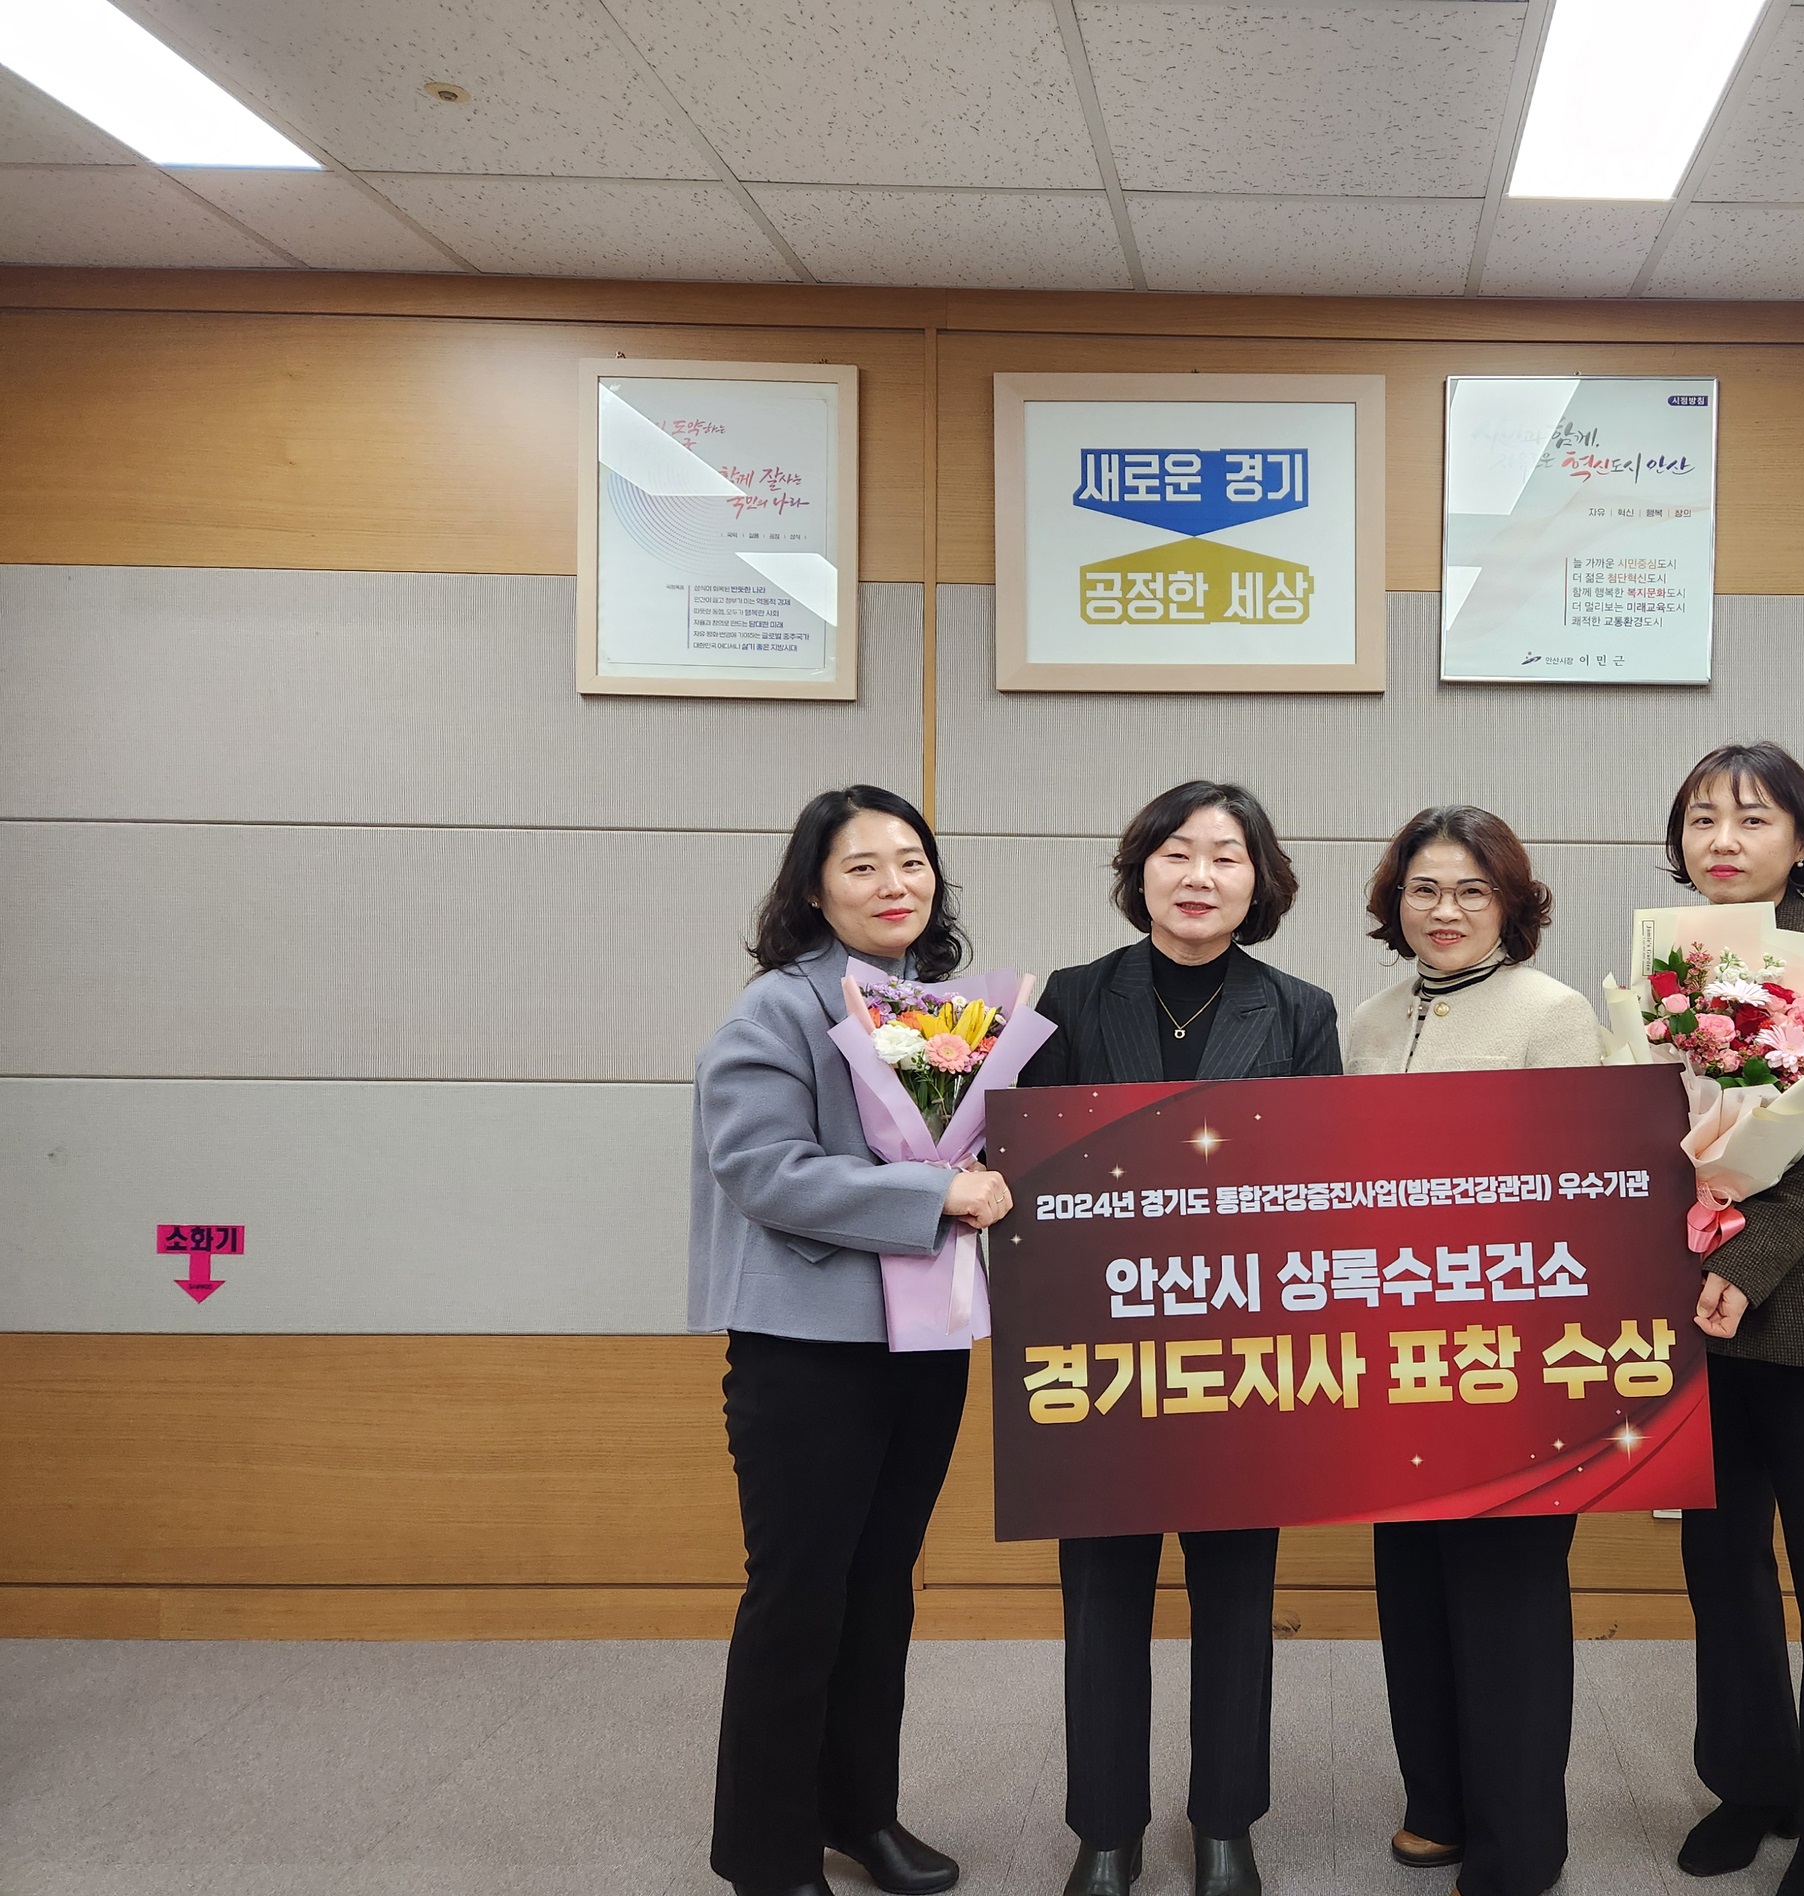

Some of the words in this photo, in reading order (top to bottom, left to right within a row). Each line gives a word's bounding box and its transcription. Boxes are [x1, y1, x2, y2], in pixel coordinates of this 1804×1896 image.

[1671, 395, 1705, 406] 시정방침
[759, 466, 802, 491] 잘사는
[1078, 453, 1202, 502] 새로운
[1225, 453, 1303, 502] 경기
[1561, 450, 1641, 484] 혁신도시
[1646, 454, 1696, 475] 안산
[726, 495, 769, 519] 국민의
[773, 492, 810, 515] 나라
[1572, 558, 1582, 569] 늘
[1585, 558, 1615, 569] 가까운
[1617, 558, 1677, 570] 시민중심도시
[1572, 573, 1582, 583] 더
[1585, 573, 1605, 584] 젊은
[1607, 573, 1667, 584] 첨단혁신도시
[1085, 571, 1209, 620] 공정한
[1223, 571, 1309, 620] 세상
[1572, 587, 1592, 598] 함께
[1594, 587, 1624, 598] 행복한
[1627, 588, 1686, 599] 복지문화도시
[1572, 601, 1582, 612] 더
[1584, 602, 1624, 613] 멀리보는
[1626, 602, 1686, 613] 미래교육도시
[1604, 616, 1663, 627] 교통환경도시
[1545, 656, 1574, 665] 안산시장
[1036, 1190, 1135, 1220] 2024년
[1140, 1188, 1211, 1218] 경기도
[1215, 1173, 1552, 1215] 통합건강증진사업(방문건강관리)
[1558, 1170, 1650, 1200] 우수기관
[165, 1226, 238, 1253] 소화기
[1105, 1252, 1261, 1318] 안산시
[1276, 1241, 1589, 1312] 상록수보건소
[1023, 1331, 1367, 1424] 경기도지사
[1387, 1323, 1522, 1404] 표창
[1541, 1318, 1677, 1400] 수상
